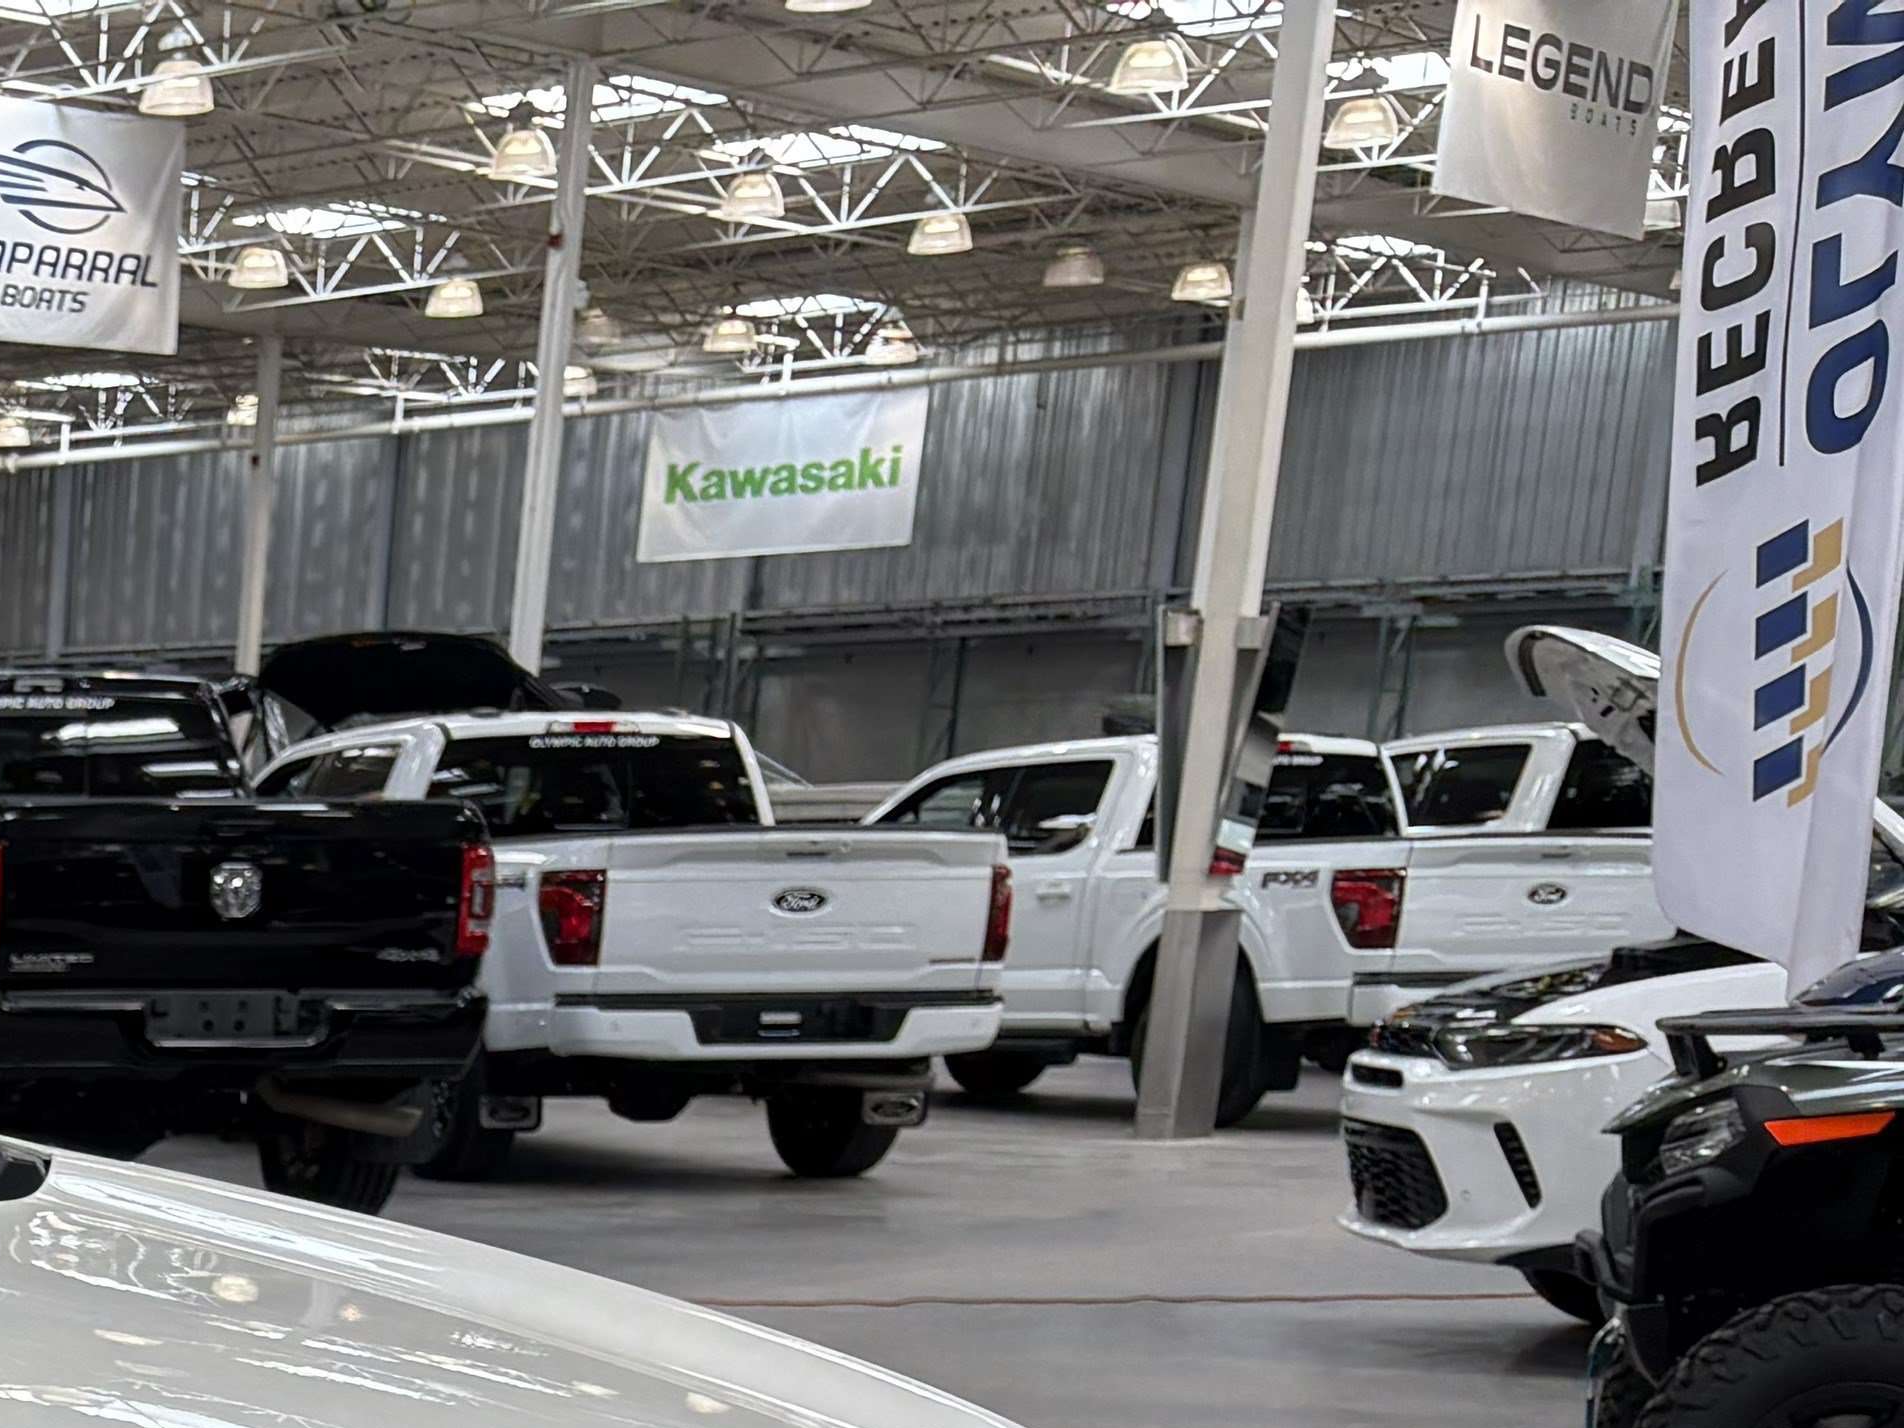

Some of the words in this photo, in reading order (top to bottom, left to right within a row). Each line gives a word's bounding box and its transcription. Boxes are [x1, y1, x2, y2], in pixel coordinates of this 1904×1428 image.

[1470, 13, 1654, 115] LEGEND
[1569, 102, 1638, 136] BOATS
[0, 283, 89, 313] BOATS
[664, 445, 905, 505] Kawasaki
